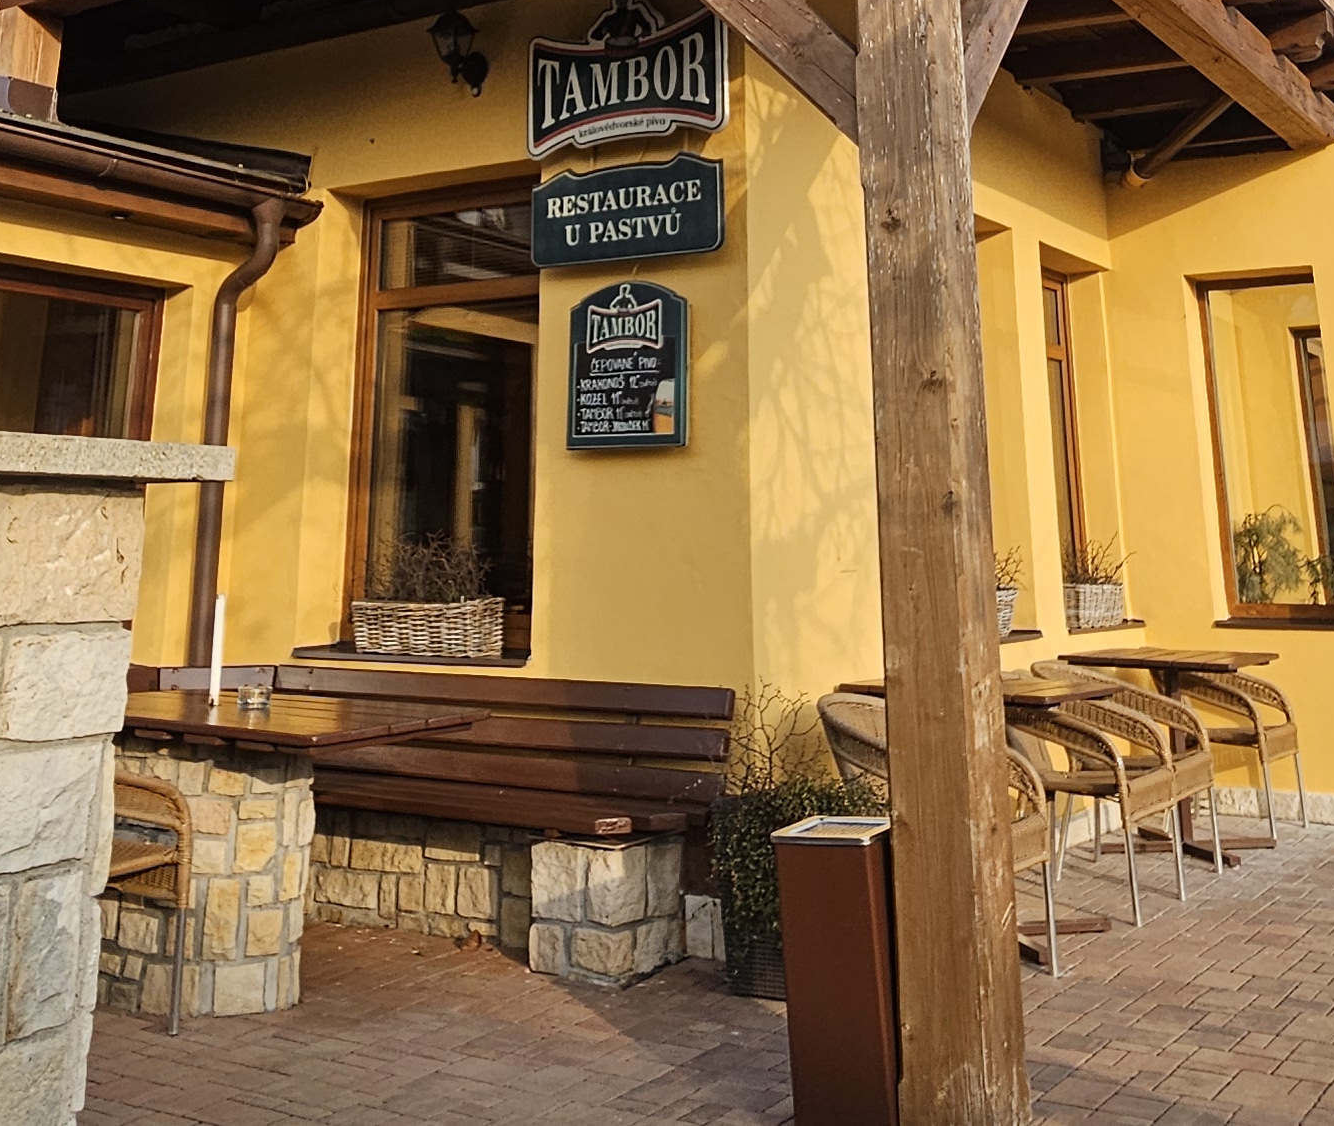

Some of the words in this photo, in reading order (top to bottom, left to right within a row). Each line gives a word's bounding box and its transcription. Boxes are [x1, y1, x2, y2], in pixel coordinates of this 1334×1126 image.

[537, 32, 710, 129] TAMBOR
[578, 117, 644, 138] královédvorské
[646, 116, 666, 128] pivo
[546, 179, 702, 219] RESTAURACE
[565, 225, 581, 246] U
[589, 208, 681, 244] PASTVŮ
[591, 309, 657, 344] TAMBOR
[580, 407, 614, 420] TAMBOR
